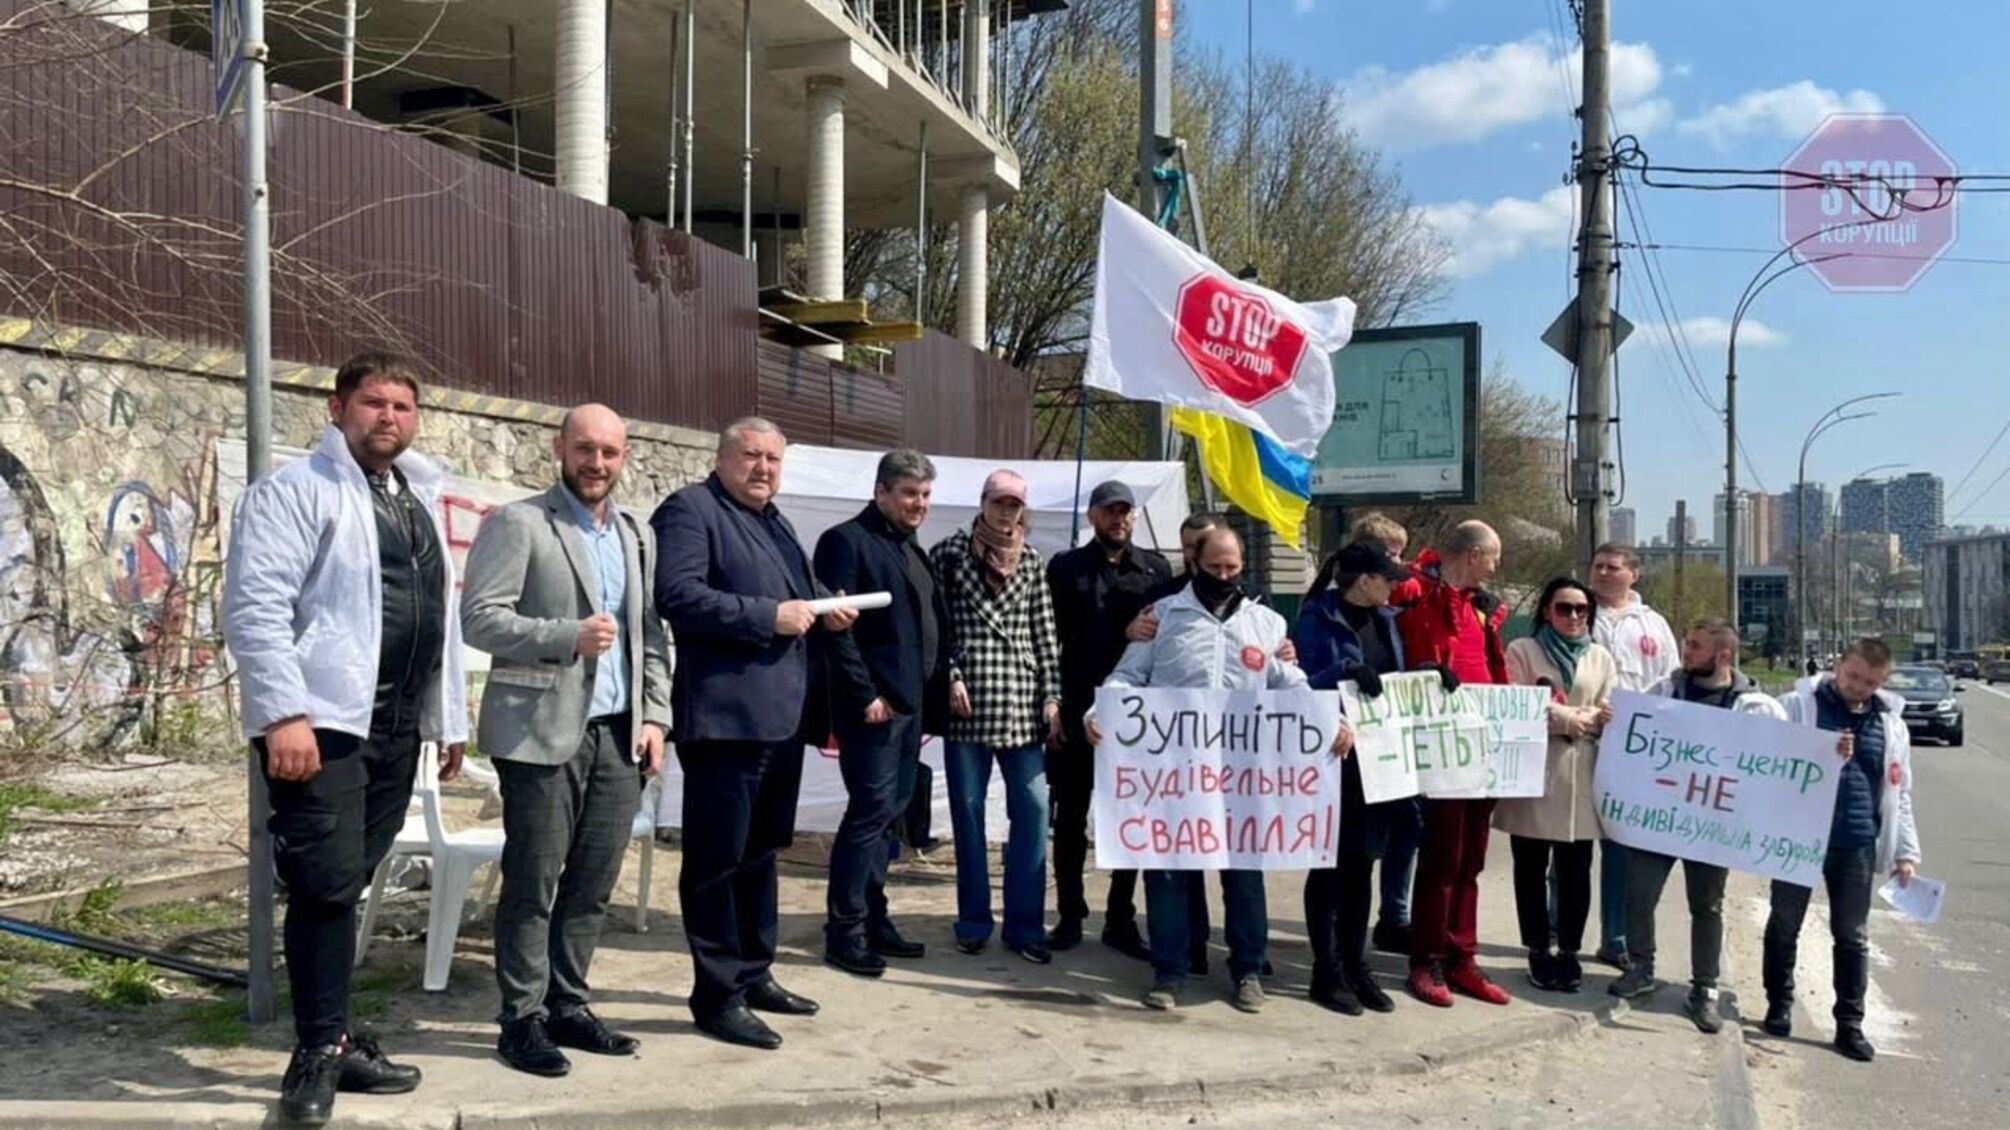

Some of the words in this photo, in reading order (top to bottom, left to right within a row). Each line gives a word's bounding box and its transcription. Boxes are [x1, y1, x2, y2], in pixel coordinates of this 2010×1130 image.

[1205, 291, 1281, 352] STOP
[1115, 695, 1323, 755] Зупиніть
[1625, 712, 1824, 794] Бізнес-центр
[1115, 759, 1320, 807] Будівельне
